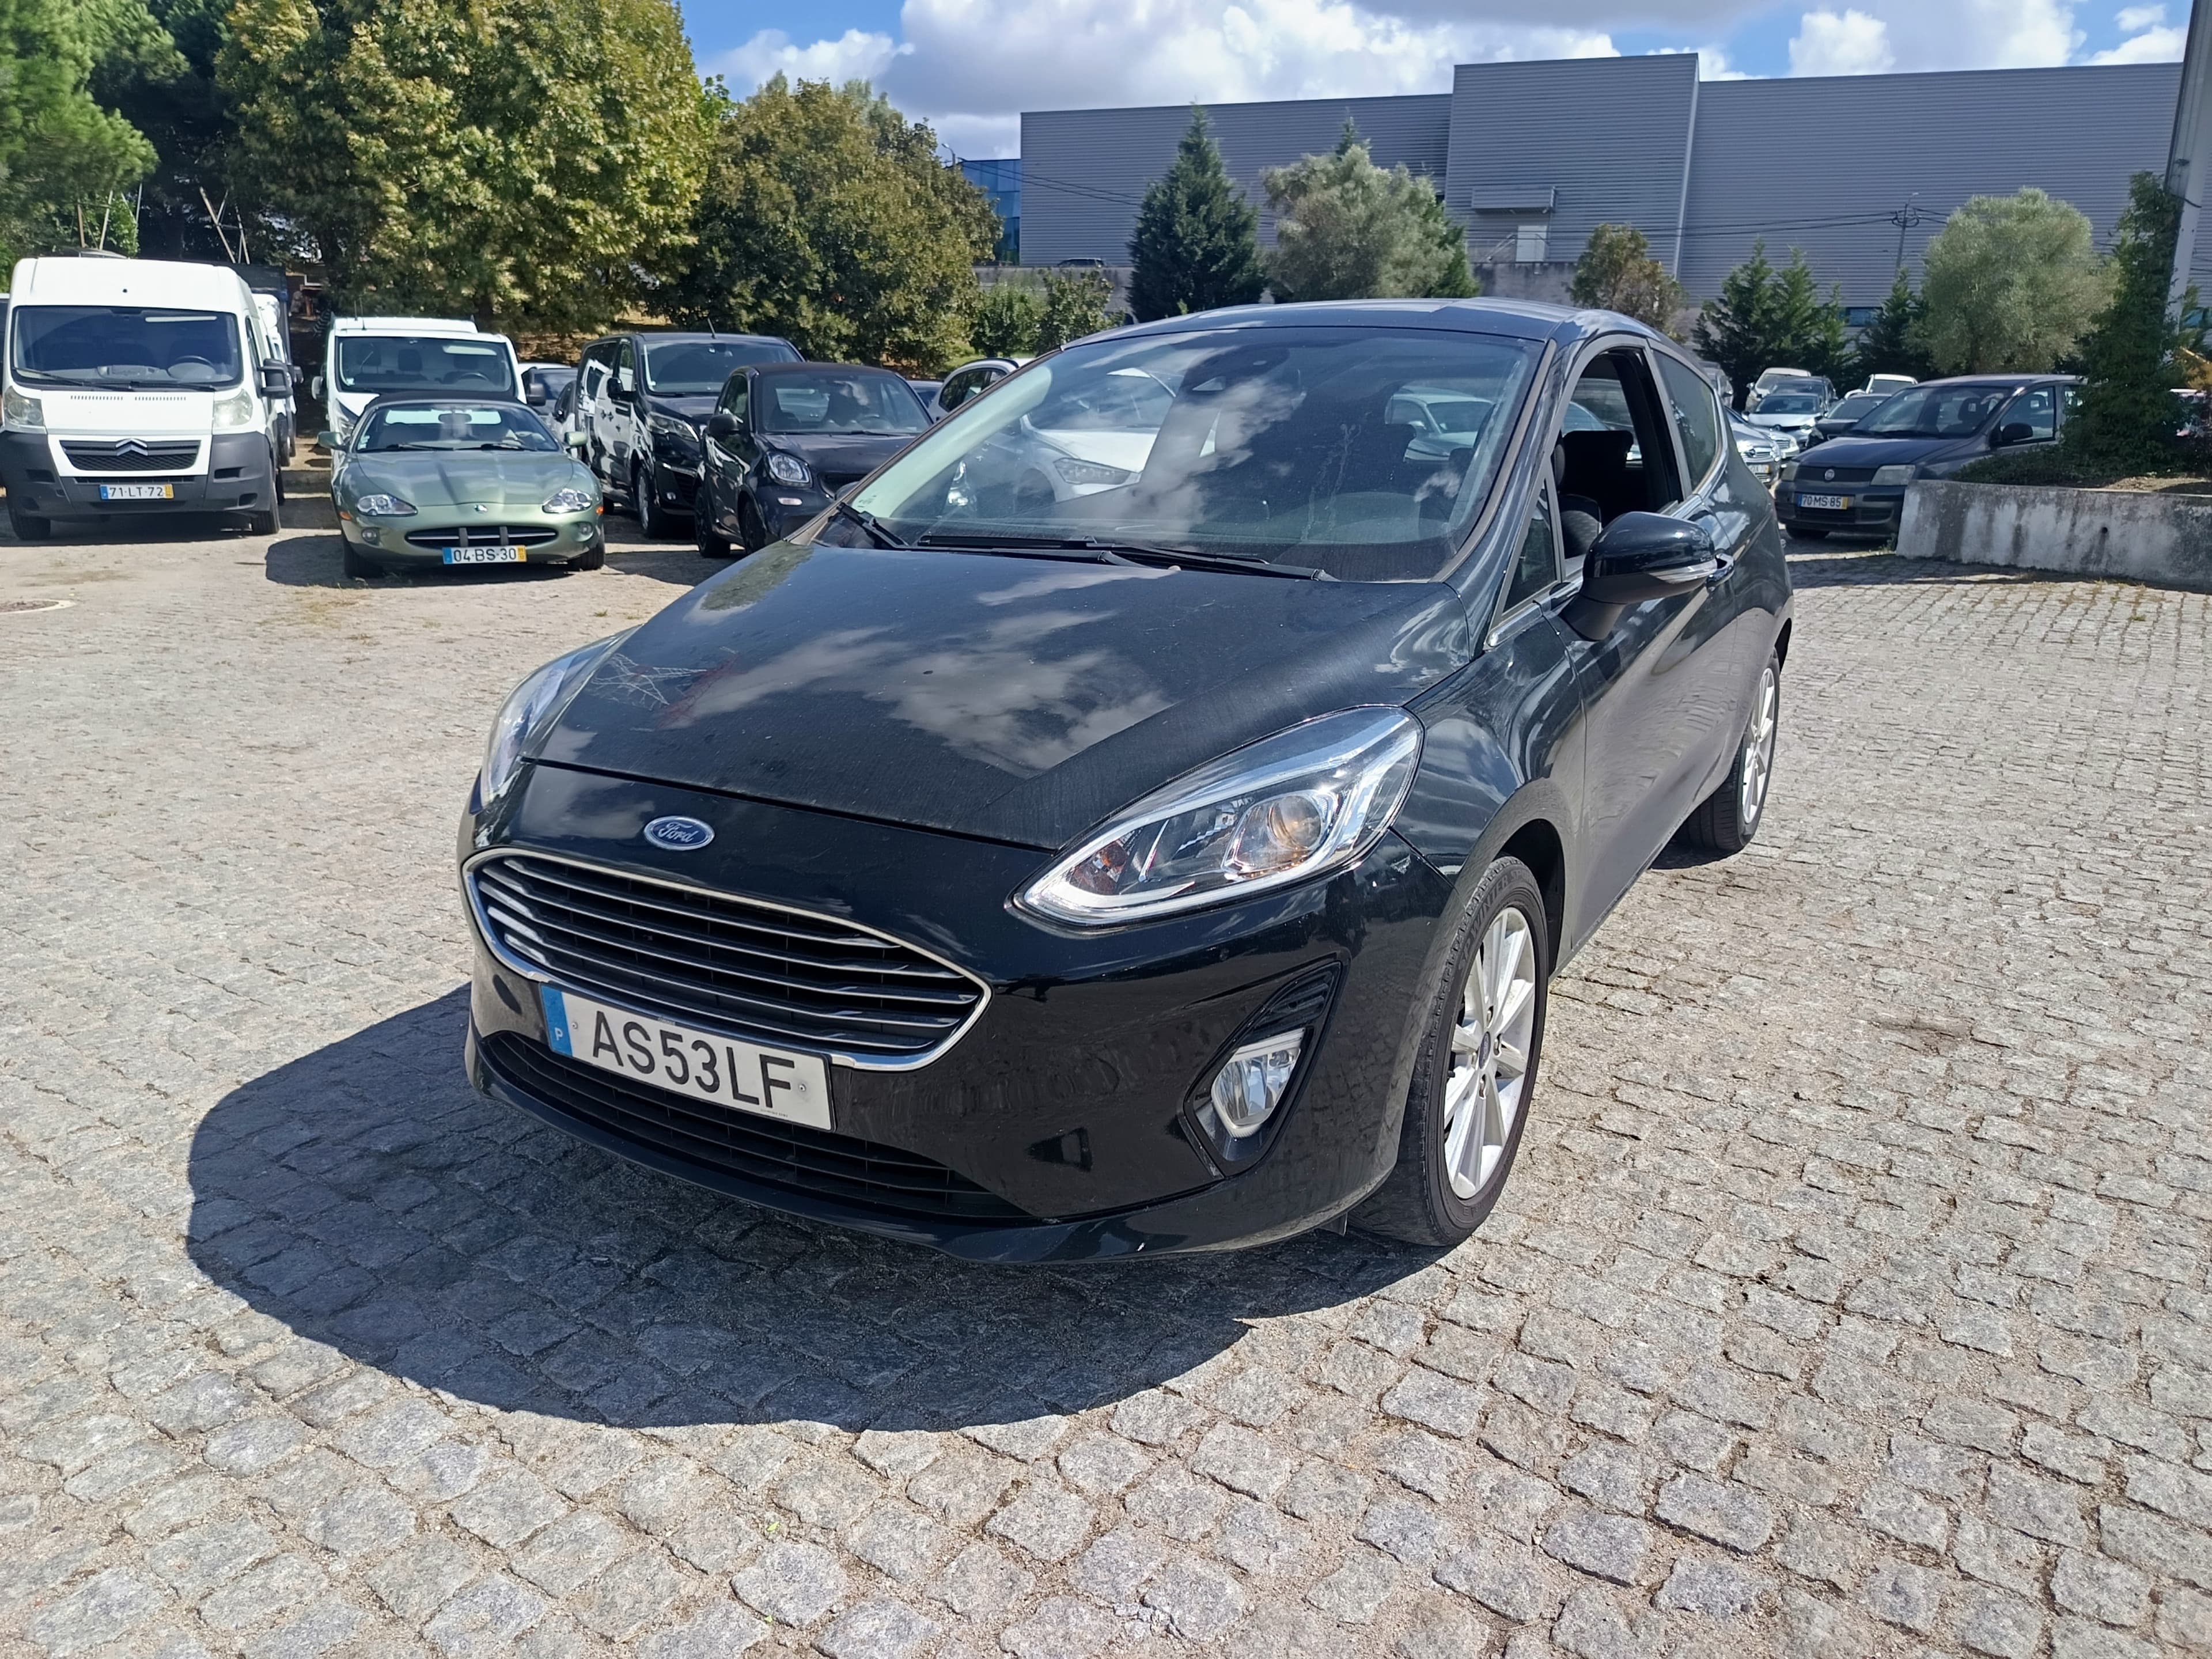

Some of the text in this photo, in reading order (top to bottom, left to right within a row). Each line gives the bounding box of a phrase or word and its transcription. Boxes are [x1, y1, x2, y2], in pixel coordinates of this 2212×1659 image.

[658, 822, 699, 842] Ford
[1471, 876, 1508, 938] WINTER
[554, 1027, 563, 1041] P
[592, 1010, 796, 1108] AS53LF
